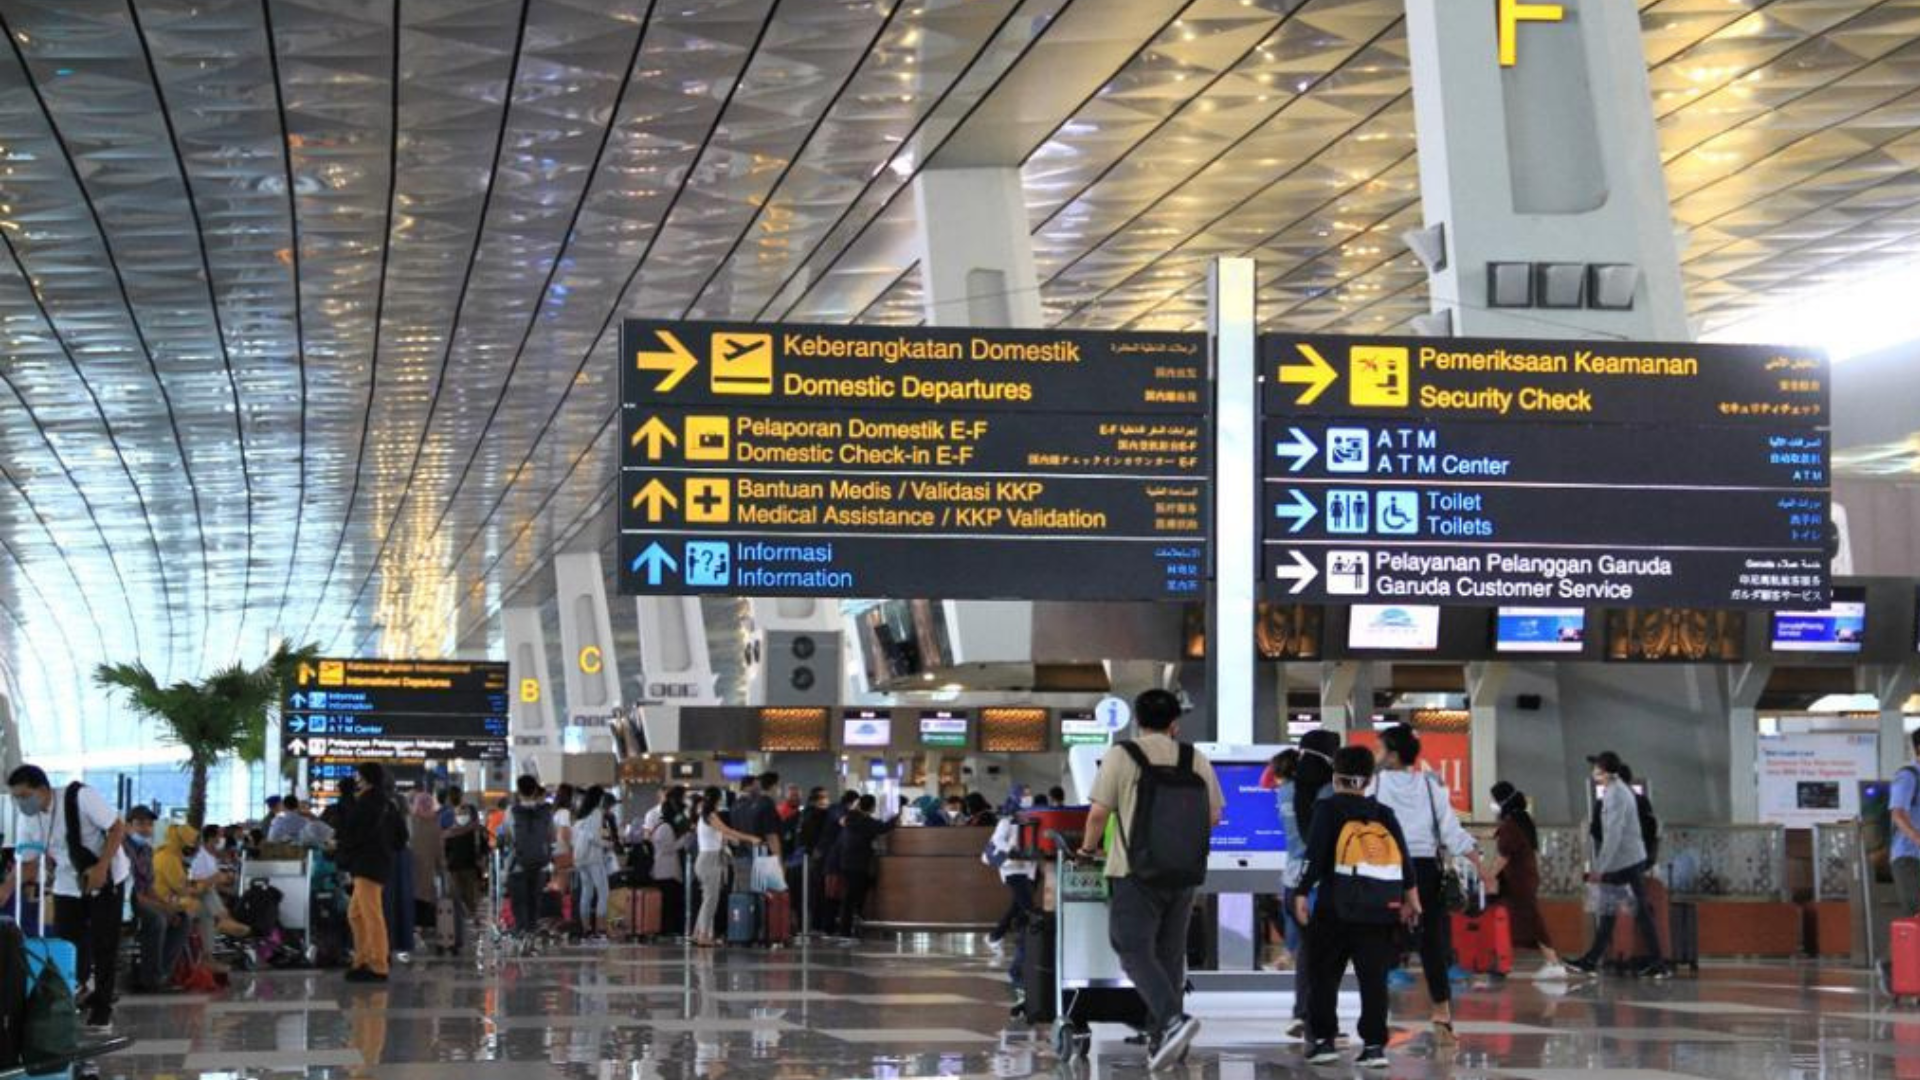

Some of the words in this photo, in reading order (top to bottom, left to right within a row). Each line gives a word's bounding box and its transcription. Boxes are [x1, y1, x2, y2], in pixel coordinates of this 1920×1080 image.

[1498, 0, 1564, 67] F
[785, 335, 962, 363] Keberangkatan
[972, 339, 1079, 361] Domestik
[1420, 347, 1567, 372] Pemeriksaan
[1575, 352, 1697, 375] Keamanan
[784, 373, 895, 397] Domestic
[902, 376, 1032, 403] Departures
[1420, 386, 1513, 414] Security
[1519, 387, 1591, 411] Check
[737, 417, 841, 440] Pelaporan
[849, 419, 944, 439] Domestik
[951, 421, 987, 439] E-F
[737, 442, 833, 462] Domestic
[840, 444, 929, 463] Check-in
[937, 446, 973, 464] E-F
[1442, 456, 1510, 475] Center
[738, 479, 823, 498] Bantuan
[830, 480, 891, 499] Medis
[911, 482, 990, 501] Validasi
[997, 482, 1042, 501] KKP
[1427, 491, 1482, 511] Toilet
[738, 504, 816, 523] Medical
[824, 506, 934, 525] Assistance
[956, 508, 1001, 526] KKP
[1007, 508, 1105, 527] Validation
[1427, 515, 1493, 535] Toilets
[738, 542, 832, 562] Informasi
[738, 567, 852, 587] Information
[1376, 551, 1480, 577] Pelayanan
[1487, 553, 1592, 580] Pelanggan
[1598, 555, 1672, 575] Garuda
[1376, 574, 1451, 596] Garuda
[1456, 576, 1553, 597] Customer
[1558, 579, 1632, 599] Service
[578, 645, 603, 675] C
[521, 679, 539, 701] B
[354, 725, 383, 734] Center
